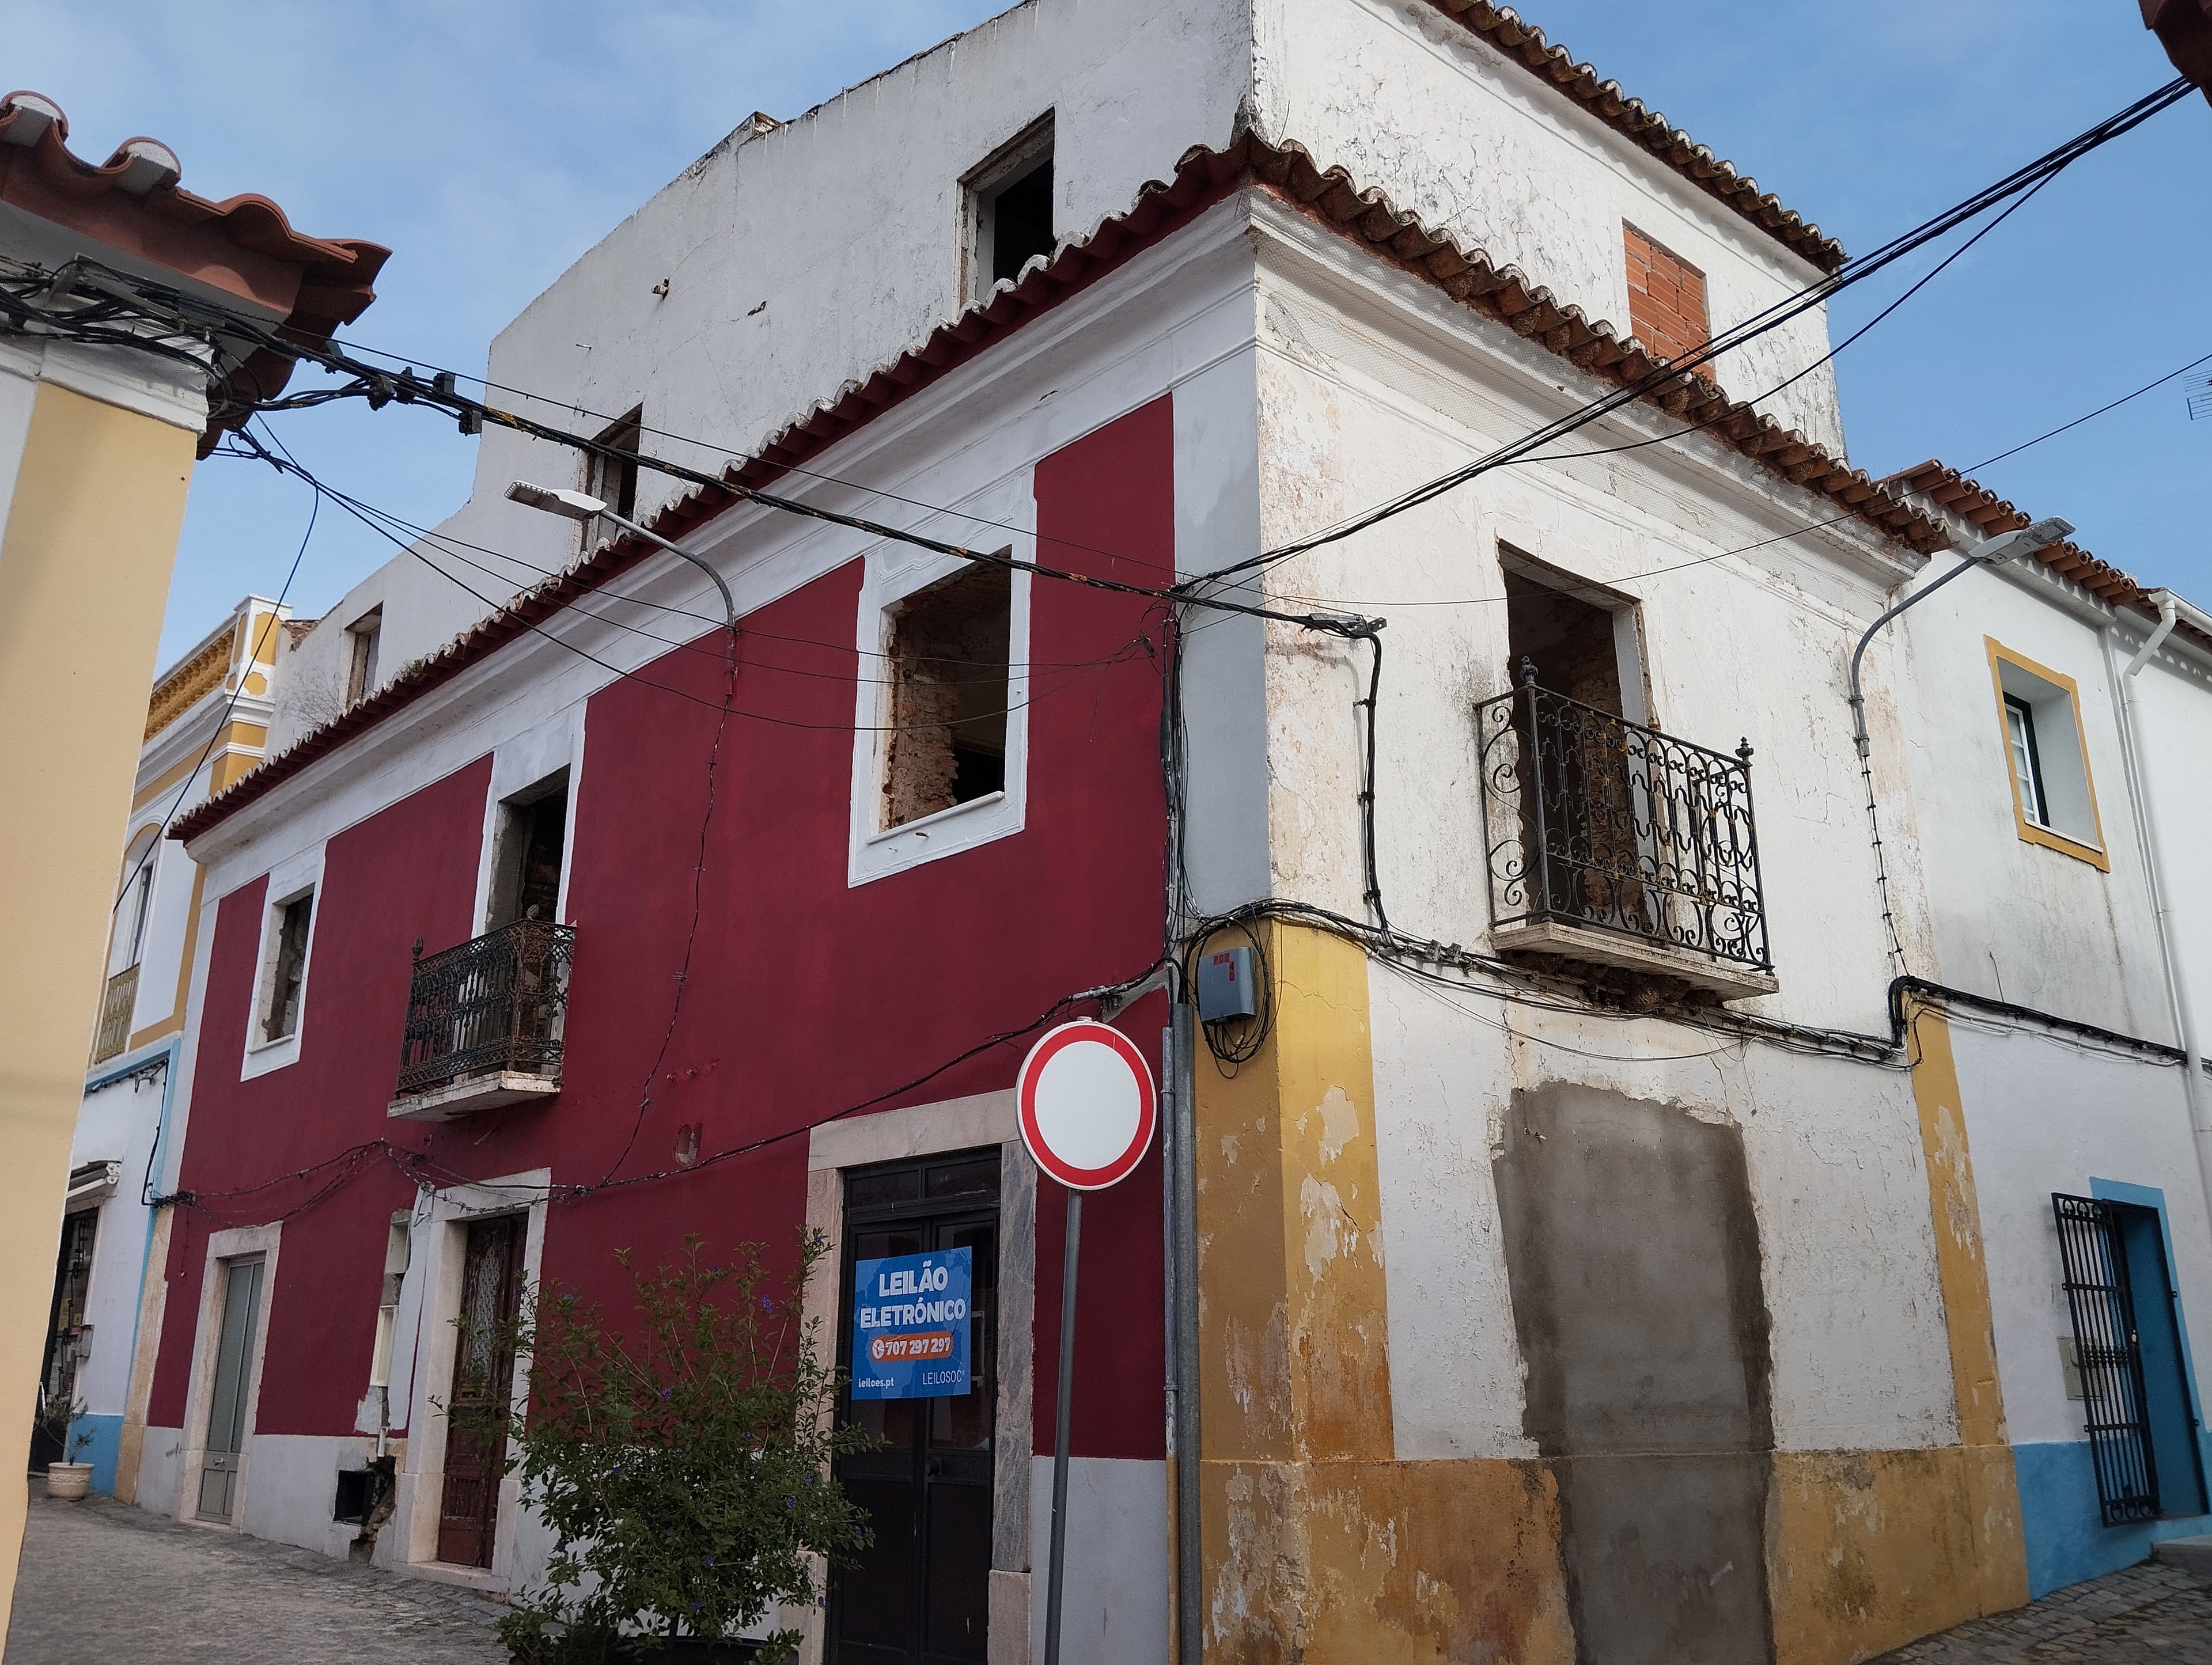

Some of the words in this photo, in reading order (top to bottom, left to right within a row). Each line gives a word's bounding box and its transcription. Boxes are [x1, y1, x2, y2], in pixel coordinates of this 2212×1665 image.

[879, 1260, 948, 1296] LEILÃO
[861, 1298, 966, 1328] ELETRÓNICO
[885, 1341, 907, 1355] 707
[909, 1340, 929, 1354] 297
[931, 1337, 950, 1352] 297
[858, 1377, 894, 1389] leiloes.pt
